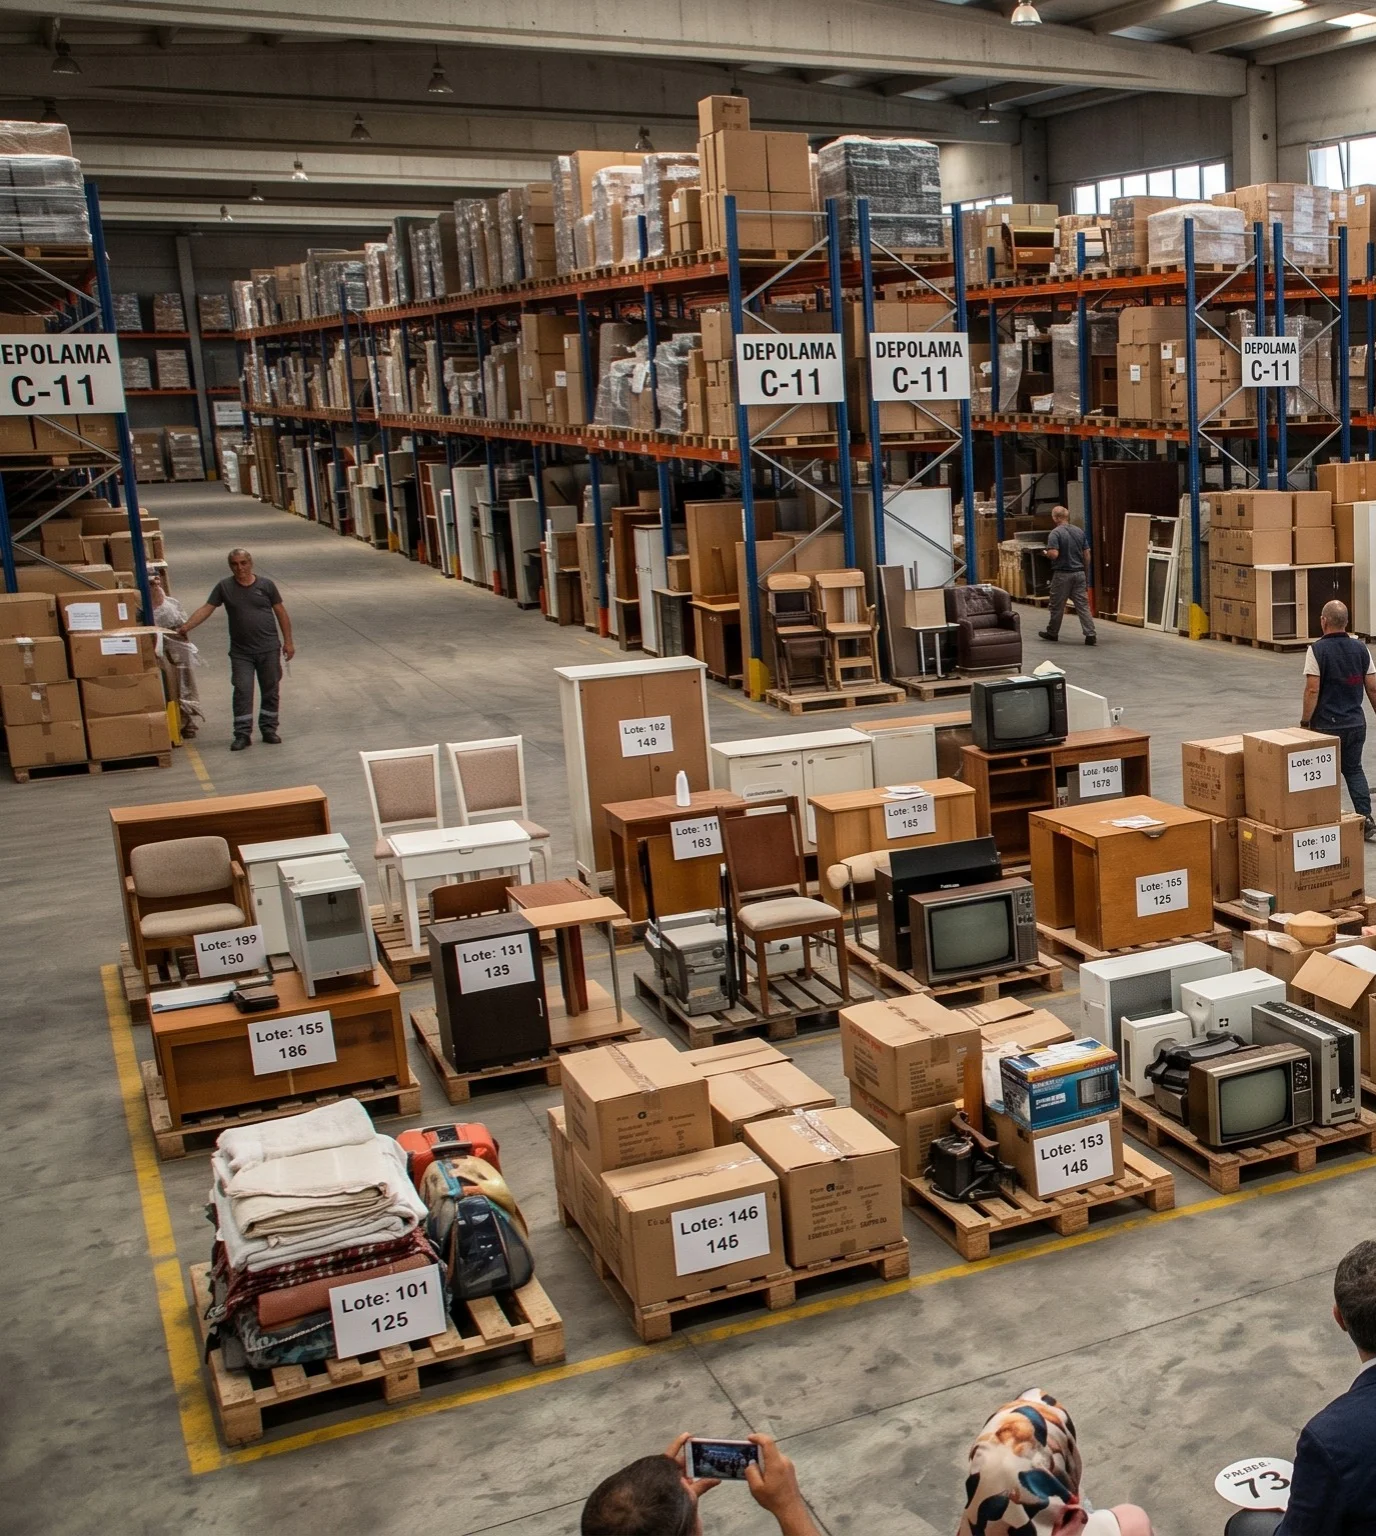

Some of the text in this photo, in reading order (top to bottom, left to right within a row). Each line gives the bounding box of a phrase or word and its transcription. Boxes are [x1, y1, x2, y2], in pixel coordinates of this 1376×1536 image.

[0, 343, 112, 365] EPOLAMA
[743, 342, 837, 361] DEPOLAMA
[876, 340, 963, 359] DEPOLAMA
[1244, 342, 1297, 355] DEPOLAMA
[892, 366, 948, 393] C-11
[1251, 360, 1289, 382] C-11
[11, 374, 95, 407] C-11
[760, 368, 820, 397] C-11
[624, 726, 646, 735] Lote:
[1291, 753, 1332, 768] Lote: 103
[1303, 770, 1322, 782] 133
[888, 807, 910, 817] Lote:
[675, 821, 718, 836] Lote: 111
[1296, 838, 1318, 848] Lote:
[1140, 882, 1163, 892] Lote:
[1153, 894, 1171, 905] 125
[200, 940, 232, 952] Lote:
[463, 943, 523, 963] Lote: 131
[220, 952, 244, 966] 150
[256, 1021, 324, 1043] Lote: 155
[278, 1044, 307, 1059] 186
[1040, 1133, 1104, 1161] Lote: 153
[680, 1216, 723, 1236] Lote:
[728, 1205, 759, 1224] 146
[341, 1280, 428, 1313] Lote: 101
[371, 1311, 409, 1333] 125
[1233, 1471, 1290, 1499] 73
